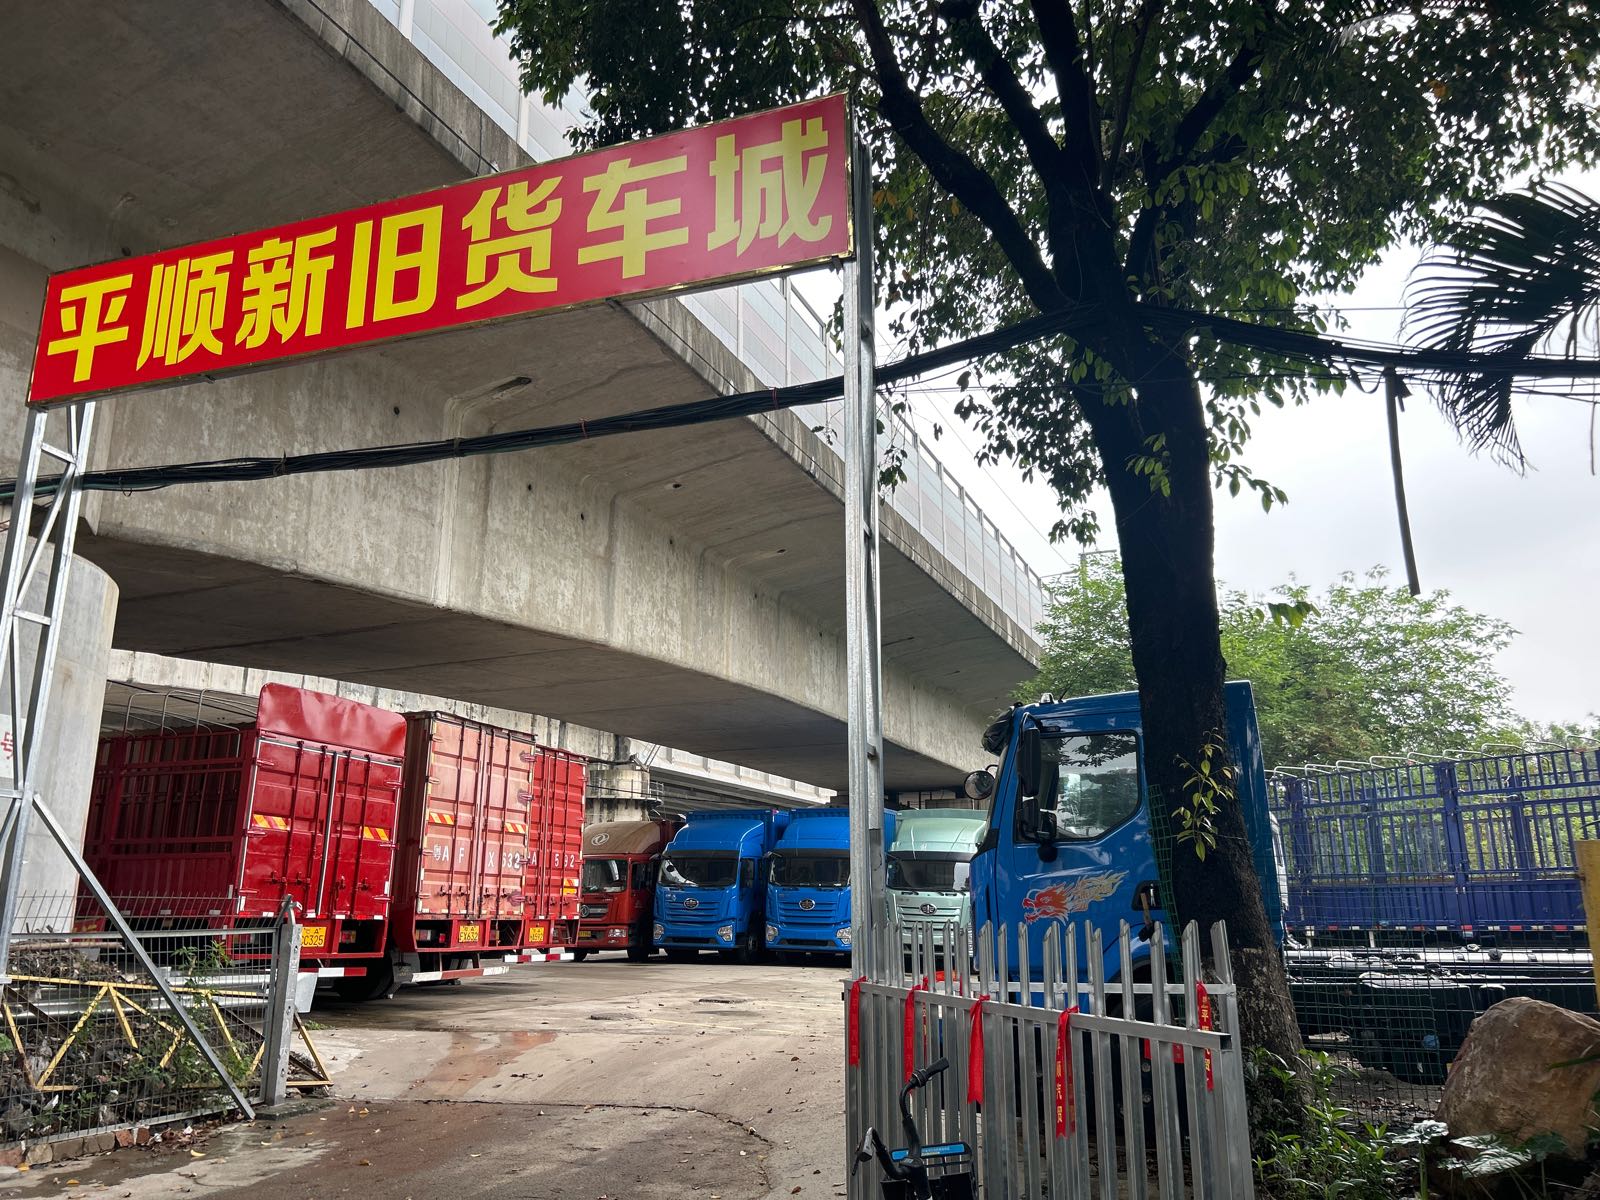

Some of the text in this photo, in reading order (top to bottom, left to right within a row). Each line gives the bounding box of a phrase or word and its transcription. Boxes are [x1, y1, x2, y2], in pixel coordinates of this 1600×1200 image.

[48, 117, 832, 382] 平顺新旧货车城
[302, 935, 324, 945] C325
